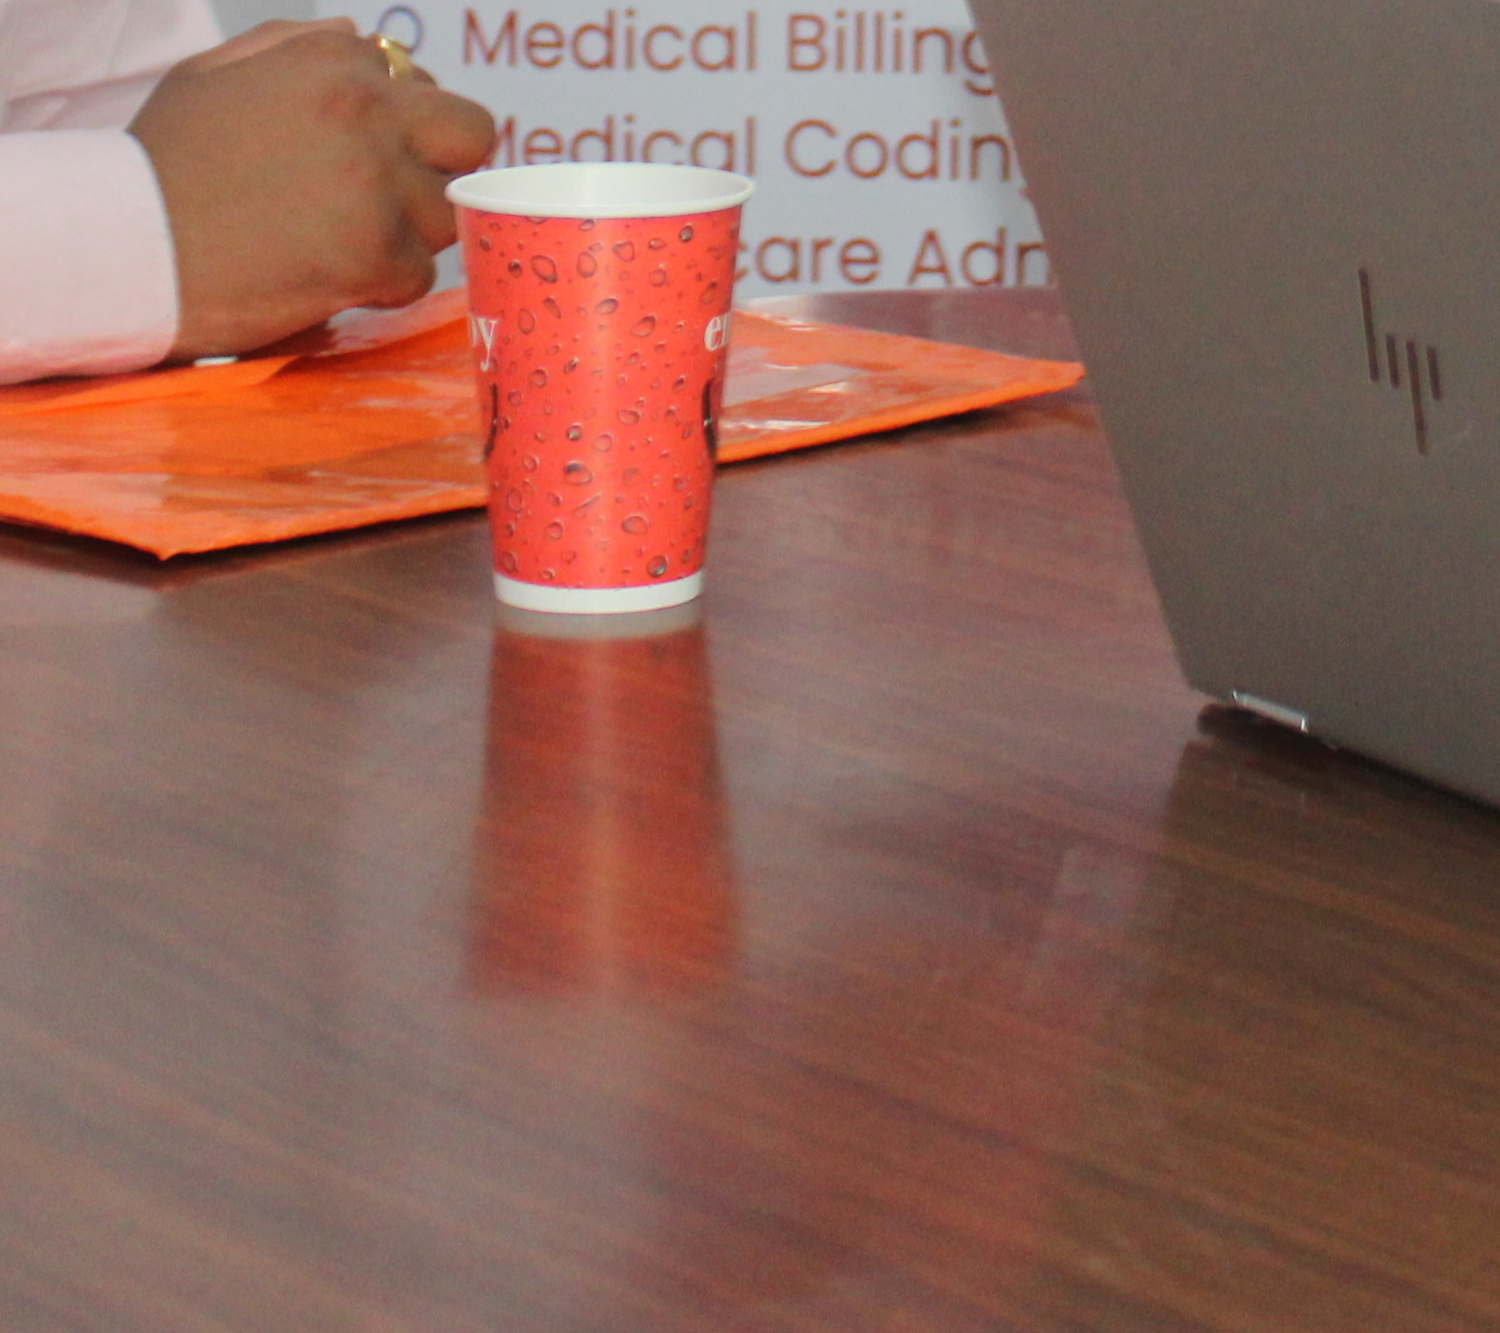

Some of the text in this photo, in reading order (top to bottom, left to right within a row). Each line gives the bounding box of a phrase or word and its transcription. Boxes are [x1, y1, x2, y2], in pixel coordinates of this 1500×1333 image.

[462, 7, 999, 97] Medical Billing
[784, 117, 1022, 189] Codin
